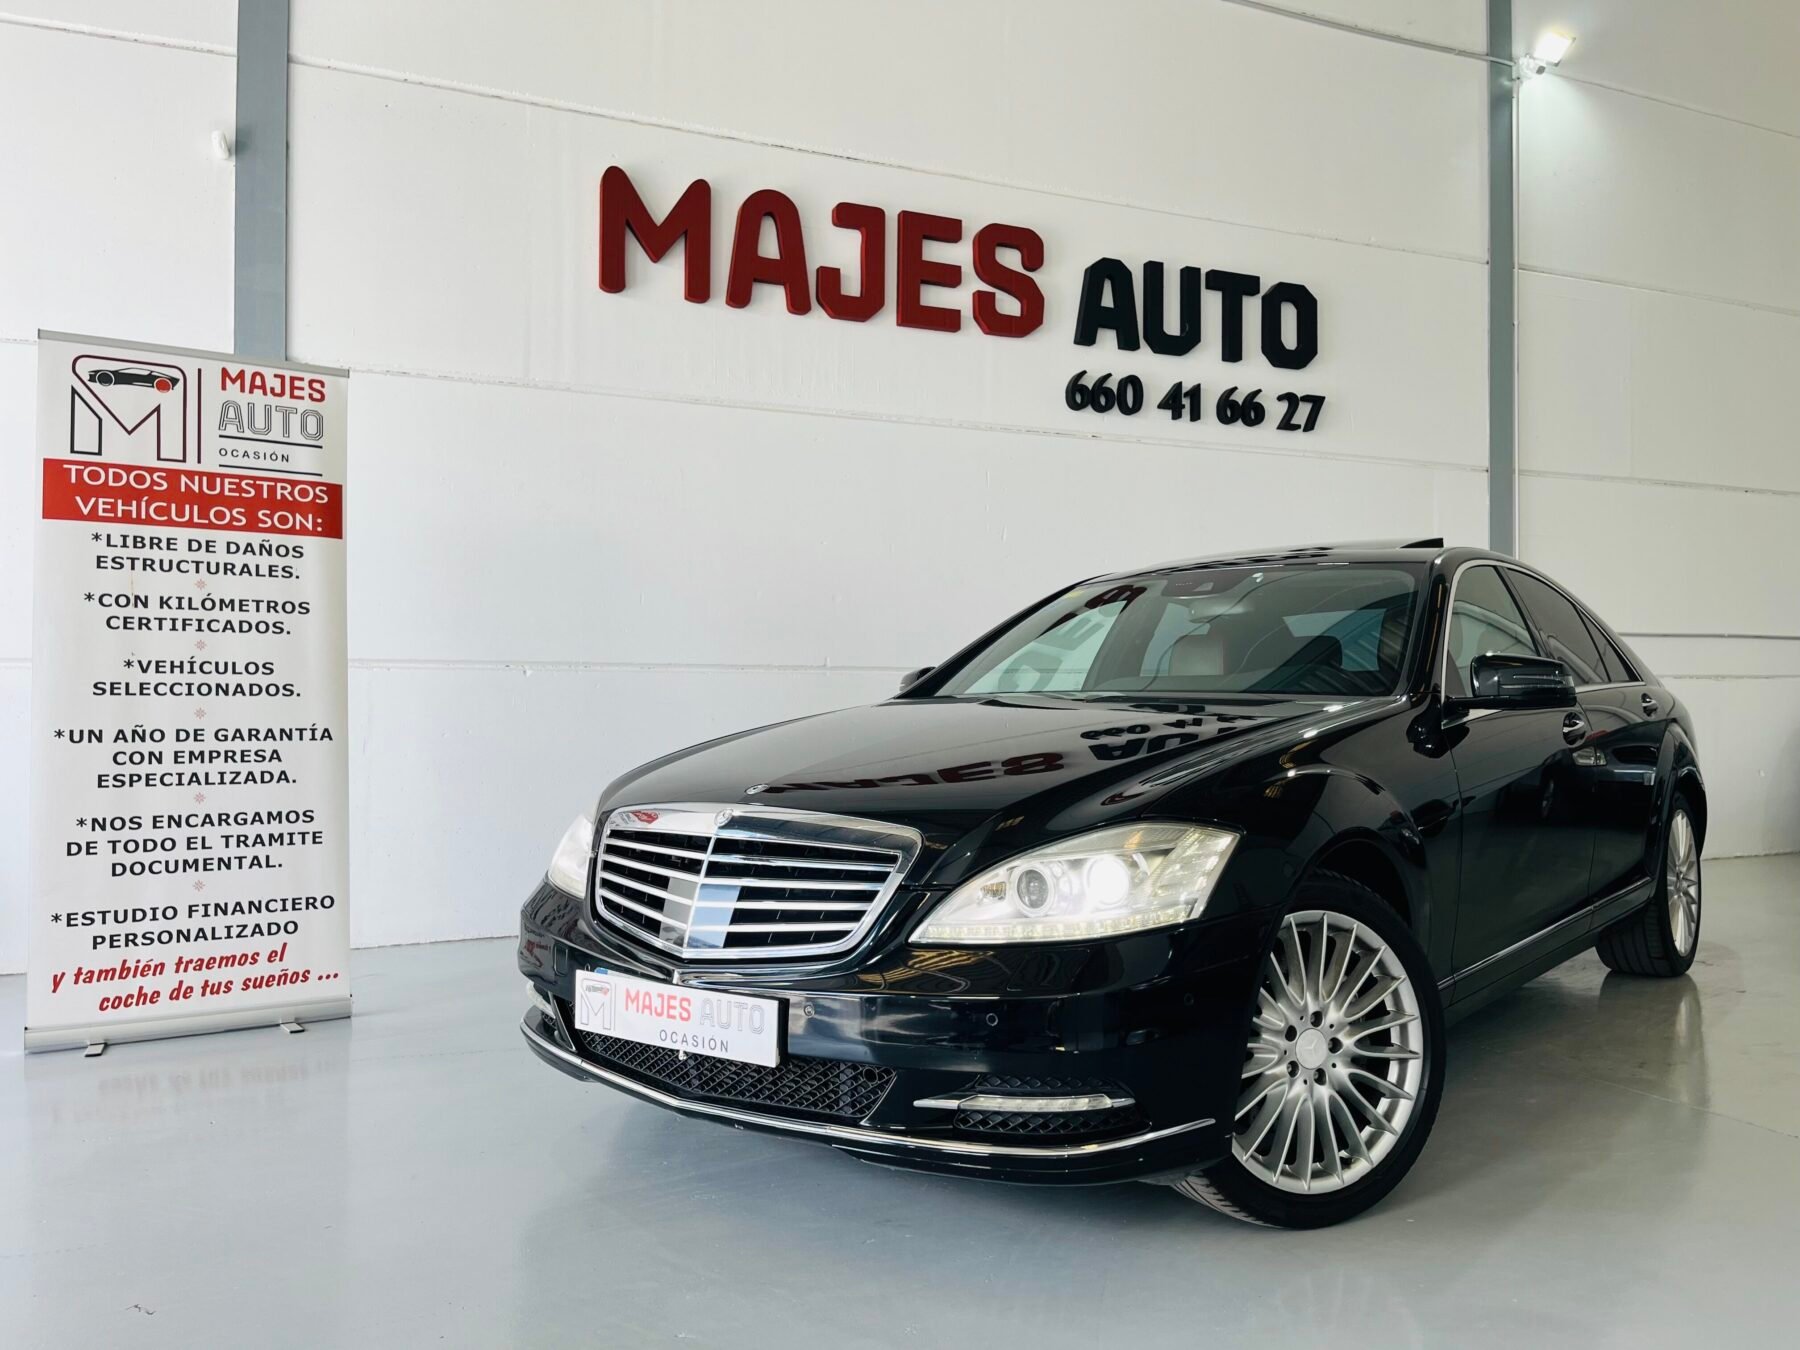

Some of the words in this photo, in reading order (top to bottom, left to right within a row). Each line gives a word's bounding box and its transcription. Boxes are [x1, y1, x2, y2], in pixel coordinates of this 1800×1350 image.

[598, 167, 1044, 336] MAJES
[1074, 257, 1318, 370] AUTO
[221, 368, 325, 402] MAJES
[1065, 370, 1144, 416] 660
[1157, 381, 1201, 422] 41
[1216, 386, 1265, 427] 66
[1276, 392, 1326, 432] 27
[218, 400, 323, 441] AUTO
[219, 448, 288, 462] OCASIÓN
[63, 465, 167, 490] TODOS
[181, 475, 328, 503] NUESTROS
[75, 496, 246, 526] VEHÍCULOS
[258, 510, 322, 531] SON:
[188, 539, 216, 553] DE
[227, 540, 303, 558] DAÑOS
[97, 556, 299, 579] ESTRUCTURALES.
[160, 596, 310, 614] KILÓMETROS
[106, 616, 290, 634] CERTIFICADOS.
[93, 682, 300, 696] SELECCIONADOS.
[113, 725, 165, 743] AÑO
[176, 729, 204, 742] DE
[214, 723, 333, 742] GARANTÍA
[113, 751, 162, 765] CON
[174, 749, 282, 764] EMPRESA
[98, 770, 296, 788] ESPECIALIZADA.
[153, 810, 314, 829] ENCARGAMOS
[67, 841, 97, 856] DE
[107, 838, 176, 854] TODO
[187, 836, 212, 850] EL
[221, 831, 322, 848] TRAMITE
[112, 855, 282, 877] DOCUMENTAL.
[188, 896, 334, 918] FINANCIERO
[93, 921, 298, 950] PERSONALIZADO
[52, 972, 65, 993] y
[74, 960, 165, 984] también
[176, 953, 259, 972] traemos
[268, 944, 286, 962] el
[100, 986, 160, 1011] coche
[169, 981, 193, 1000] de
[201, 980, 232, 995] tus
[243, 970, 309, 991] sueños
[625, 988, 691, 1022] MAJES
[700, 998, 765, 1034] AUTO
[660, 1030, 727, 1052] OCASIÓN
